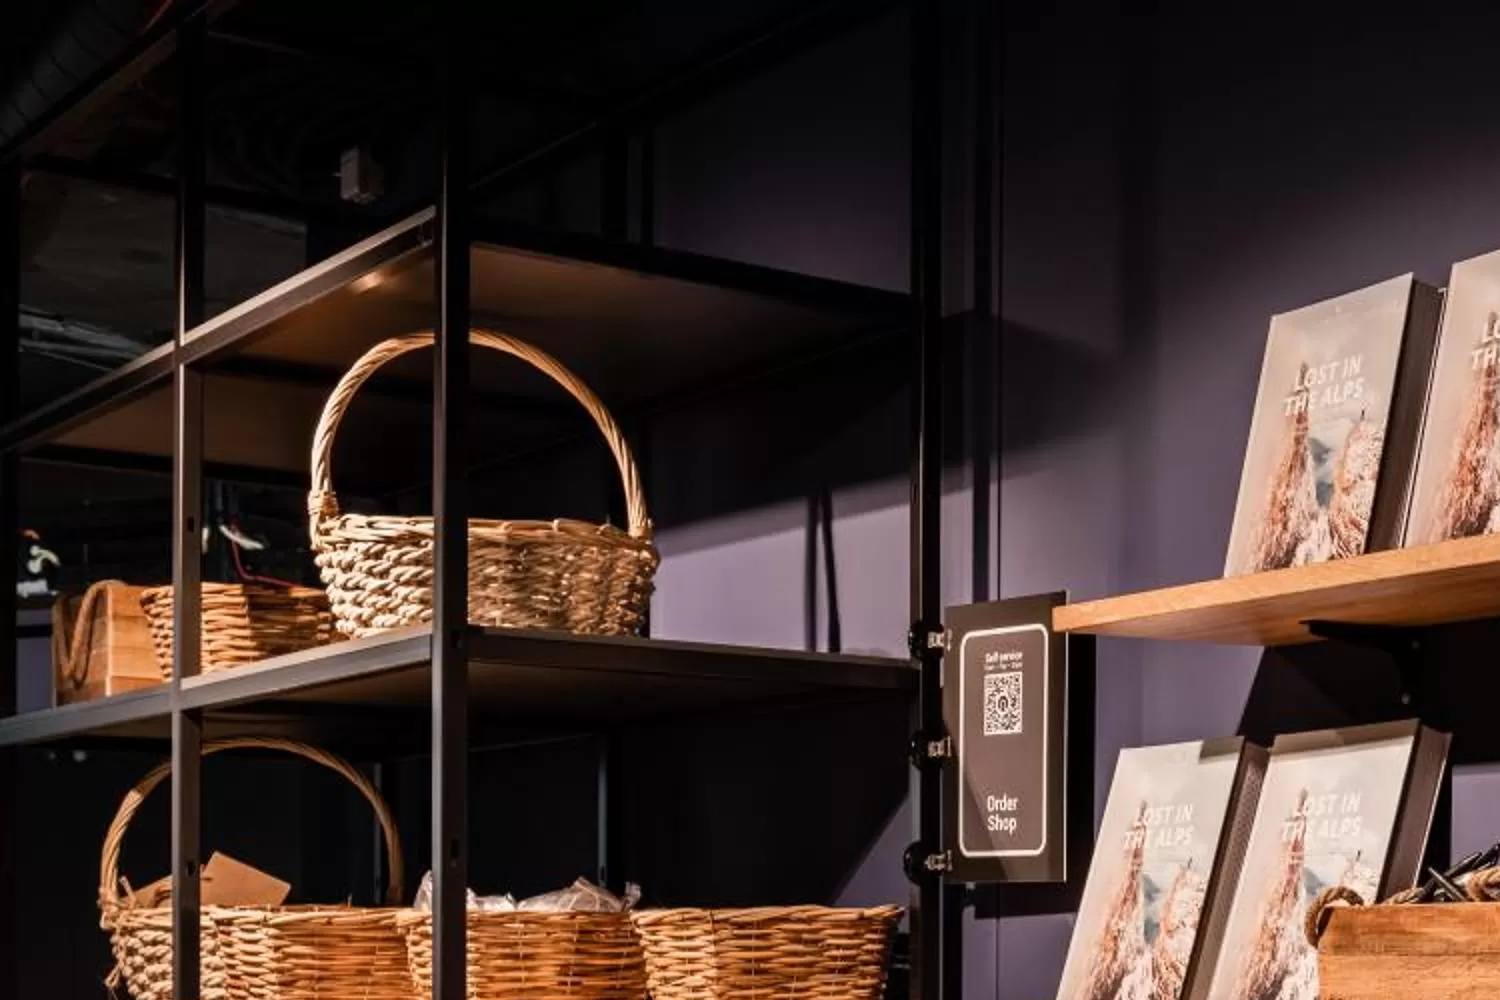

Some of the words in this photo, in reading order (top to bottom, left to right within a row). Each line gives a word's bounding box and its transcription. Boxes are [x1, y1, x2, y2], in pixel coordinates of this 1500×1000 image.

[1294, 361, 1340, 390] LOST
[1342, 354, 1362, 377] IN
[1283, 391, 1316, 417] THE
[1320, 377, 1365, 407] ALPS
[987, 793, 1018, 812] Order
[1293, 793, 1340, 816] LOST
[1341, 791, 1361, 813] IN
[987, 815, 1017, 835] Shop
[1132, 806, 1174, 826] LOST
[1175, 803, 1193, 821] IN
[1153, 824, 1195, 846] ALPS
[1317, 815, 1362, 837] ALPS
